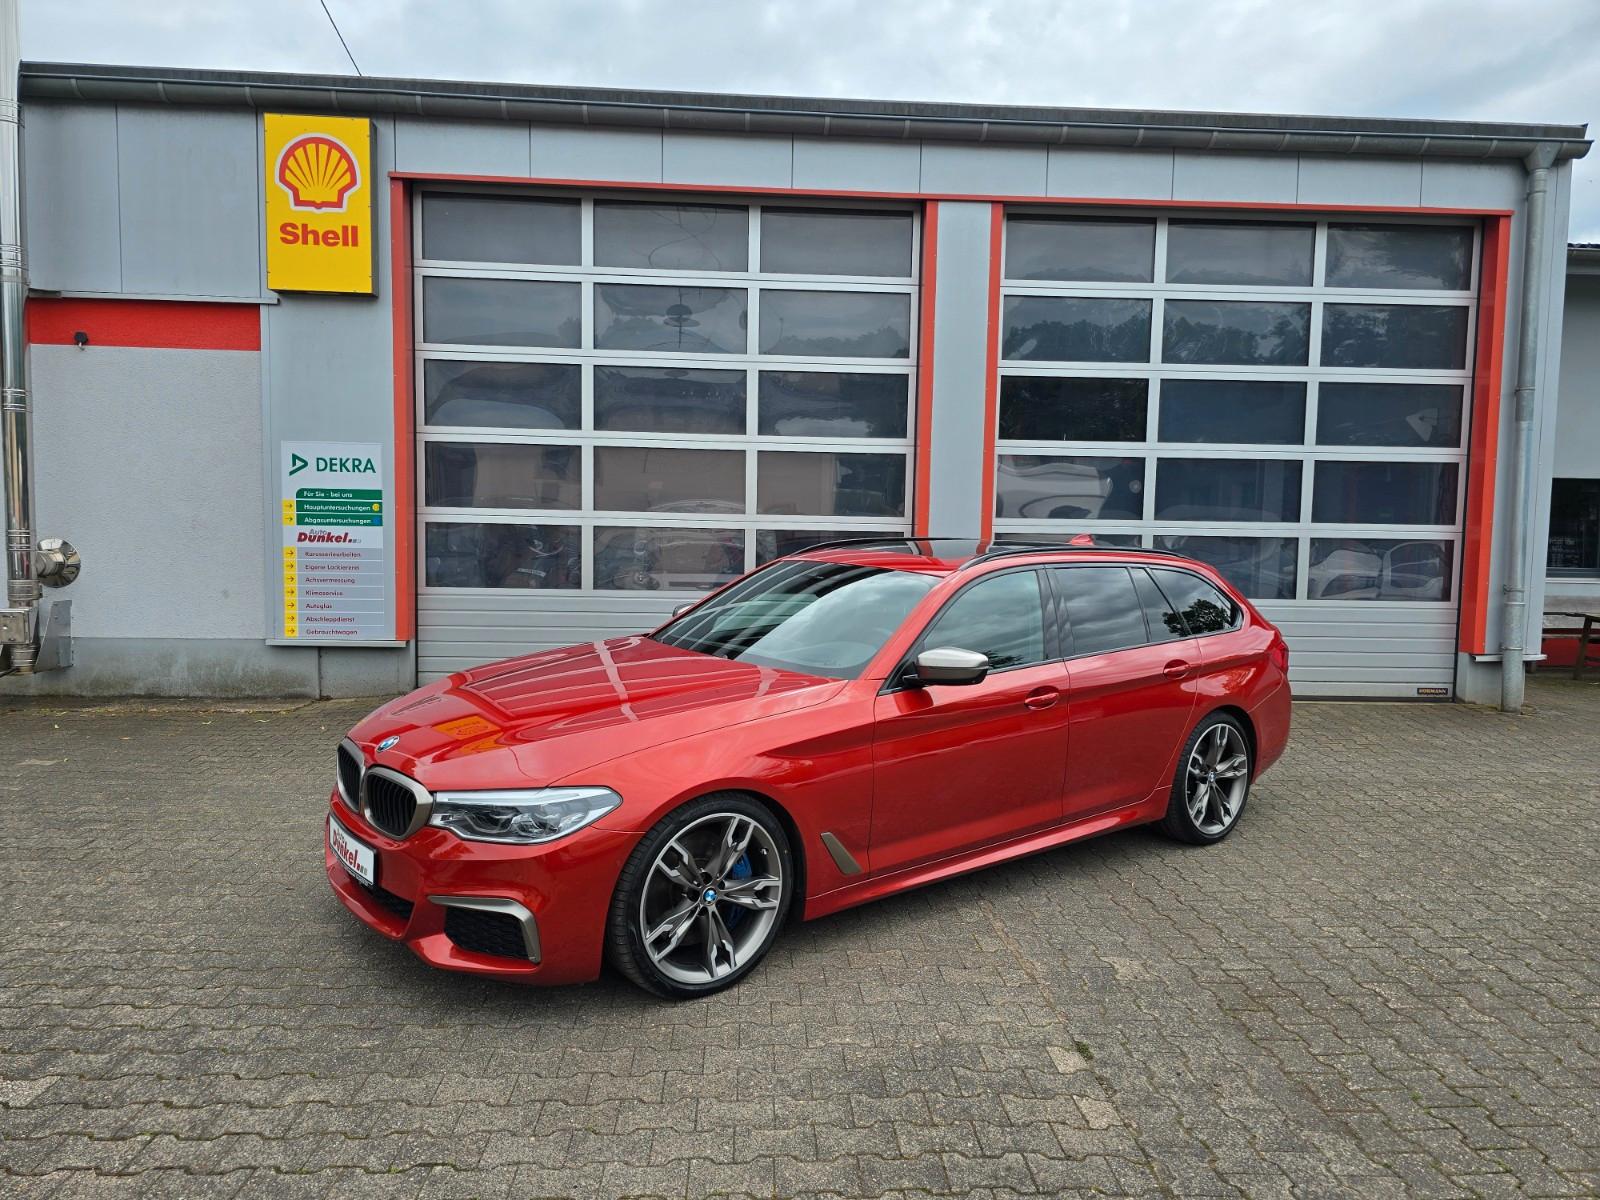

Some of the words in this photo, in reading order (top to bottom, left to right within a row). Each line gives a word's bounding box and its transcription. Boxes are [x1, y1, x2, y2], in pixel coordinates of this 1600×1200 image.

[280, 222, 359, 247] Shell
[316, 457, 376, 473] DEKRA
[304, 517, 372, 525] Abgasuntersuchungen
